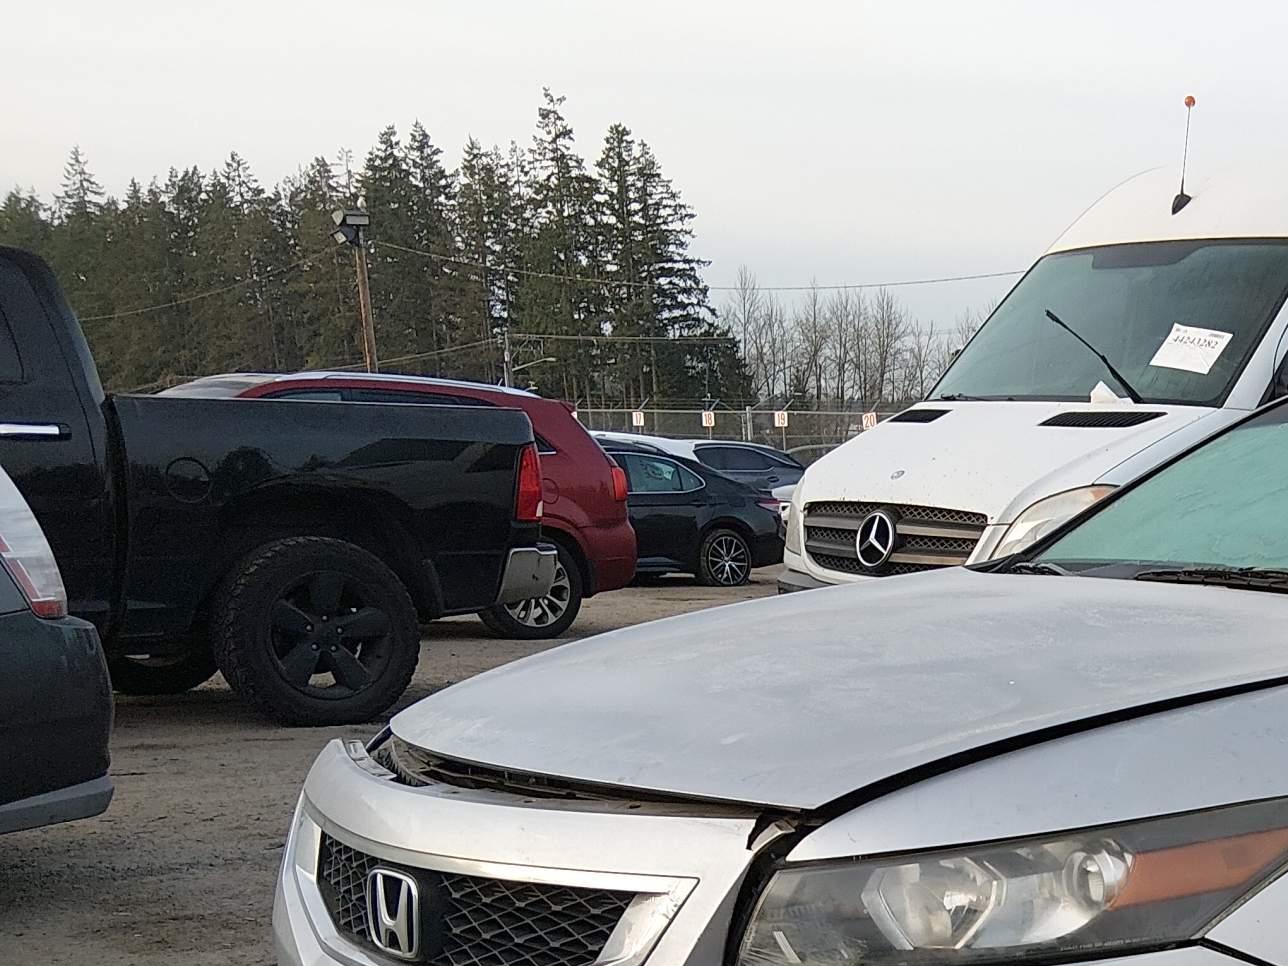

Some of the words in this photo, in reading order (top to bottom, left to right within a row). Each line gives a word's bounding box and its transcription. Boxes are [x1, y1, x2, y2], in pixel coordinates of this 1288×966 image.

[704, 412, 713, 425] 18
[777, 414, 786, 426] 19
[864, 414, 875, 428] 20
